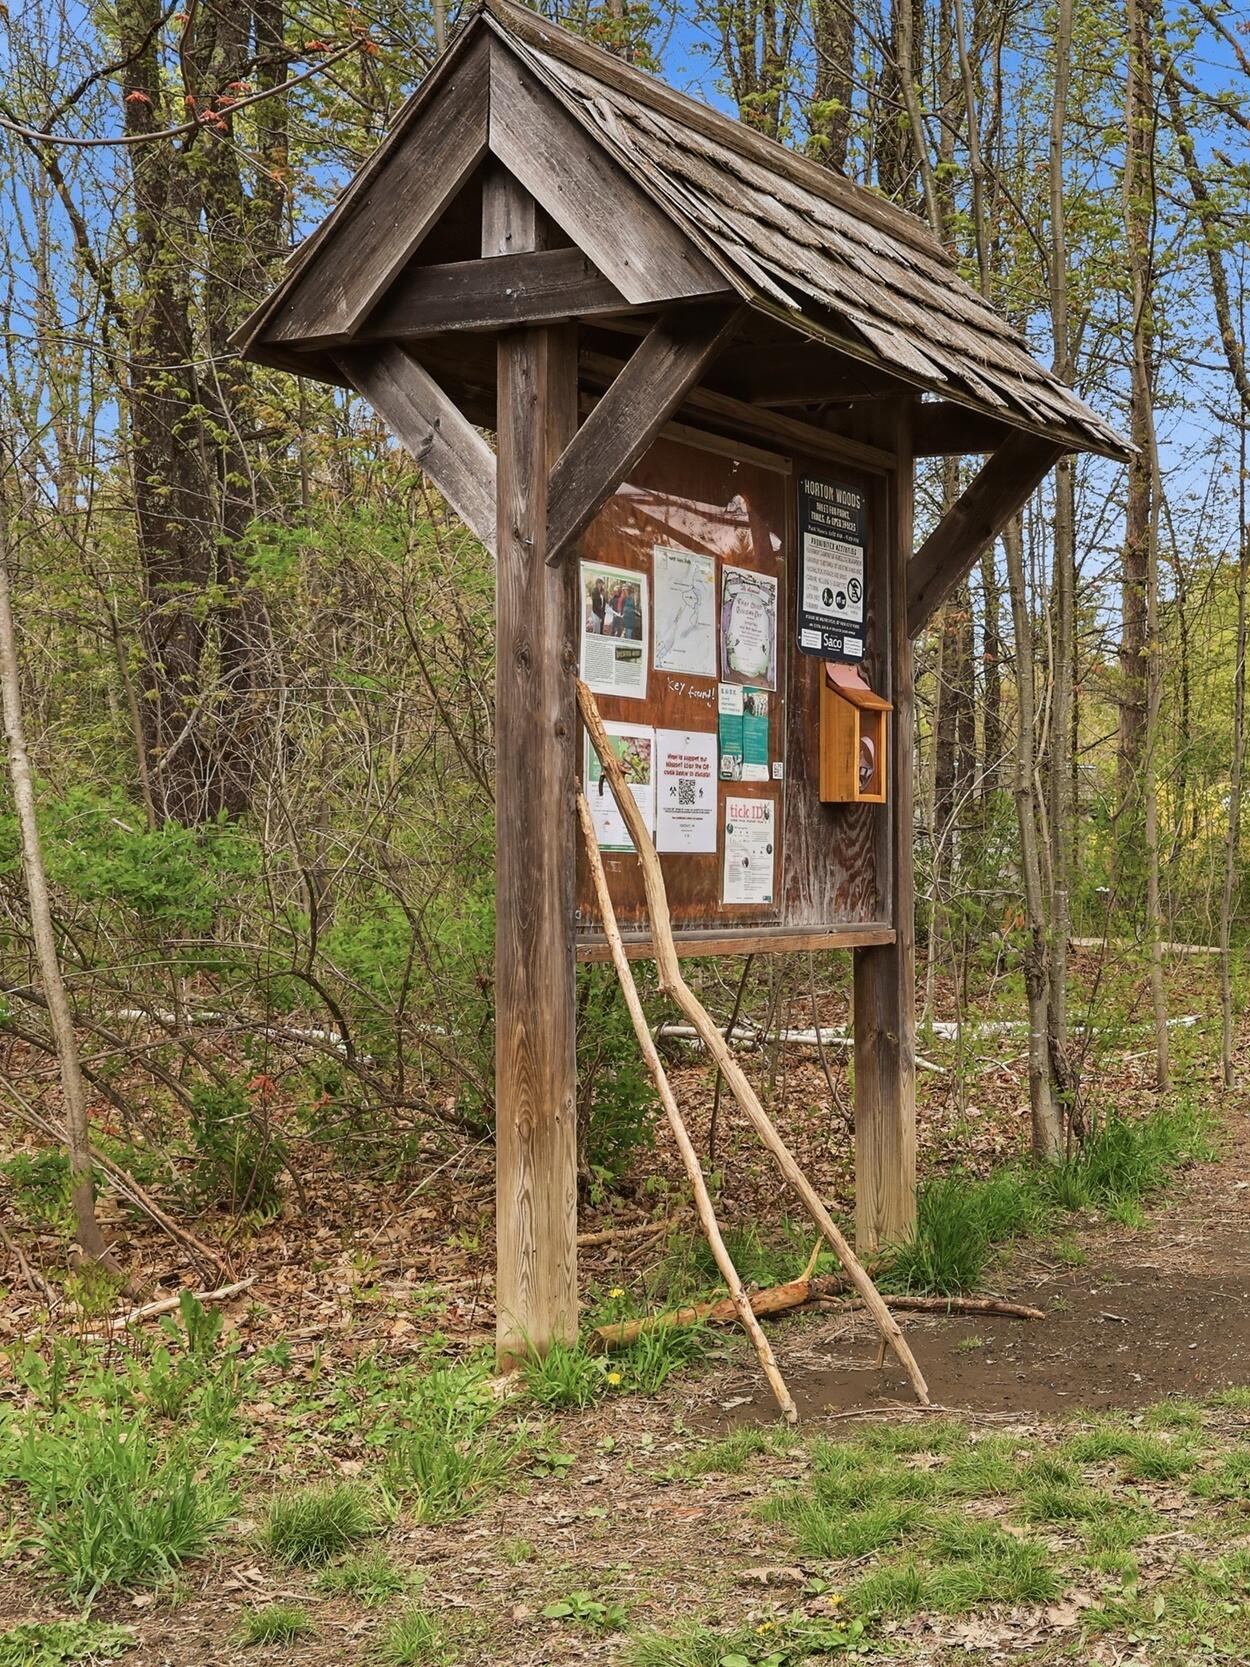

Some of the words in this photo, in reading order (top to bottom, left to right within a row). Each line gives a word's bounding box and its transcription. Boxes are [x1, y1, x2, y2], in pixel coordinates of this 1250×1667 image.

[804, 479, 834, 501] HORTON
[836, 488, 861, 509] WOODS
[823, 633, 843, 649] Saco
[730, 803, 750, 819] tick
[751, 805, 764, 820] ID
